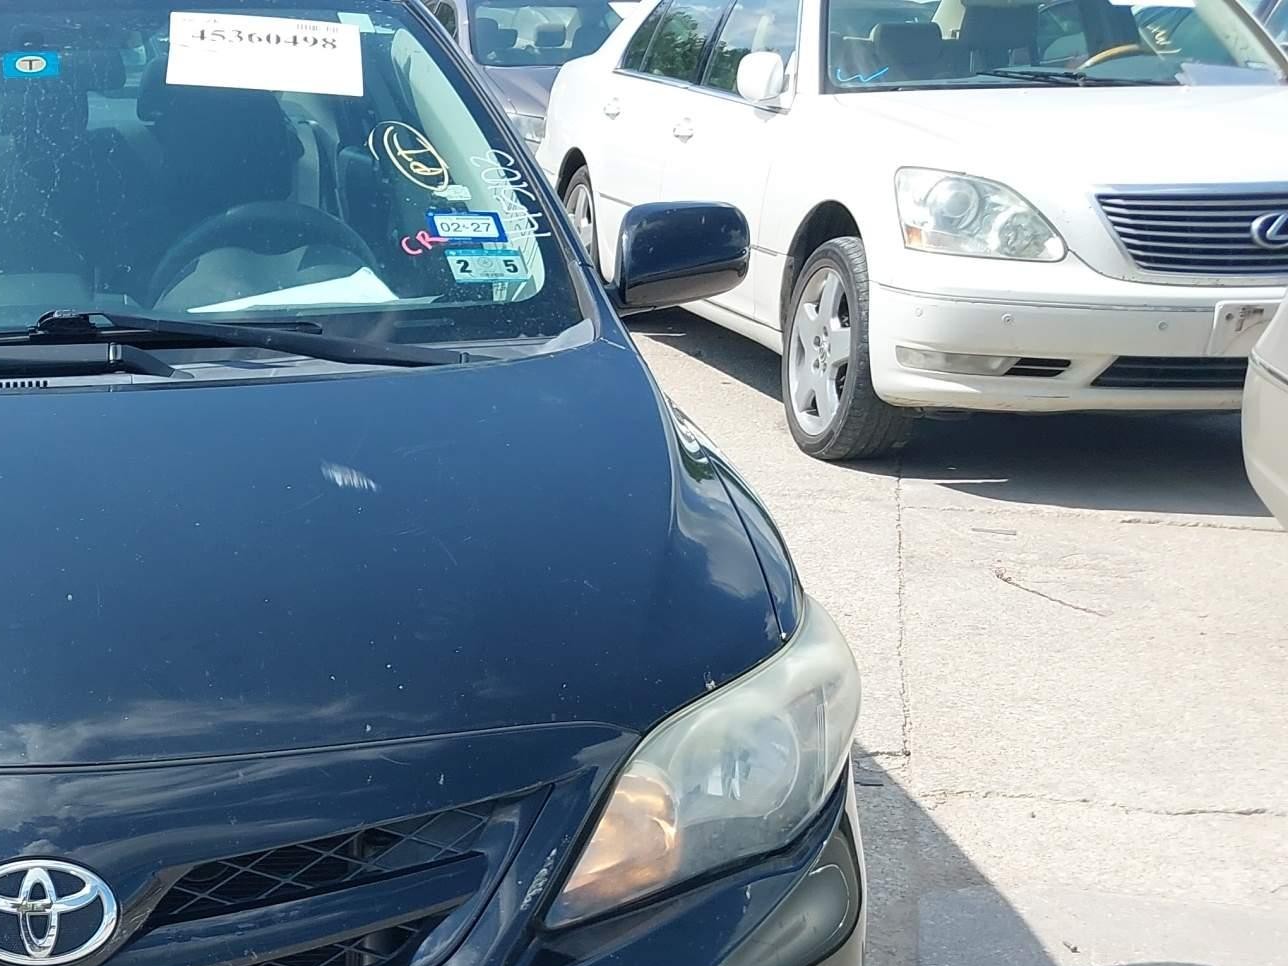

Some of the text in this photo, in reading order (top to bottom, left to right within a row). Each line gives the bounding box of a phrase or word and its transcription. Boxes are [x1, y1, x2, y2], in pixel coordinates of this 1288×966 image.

[192, 29, 338, 50] 45360498
[401, 230, 449, 255] CR
[456, 259, 519, 273] 2 5
